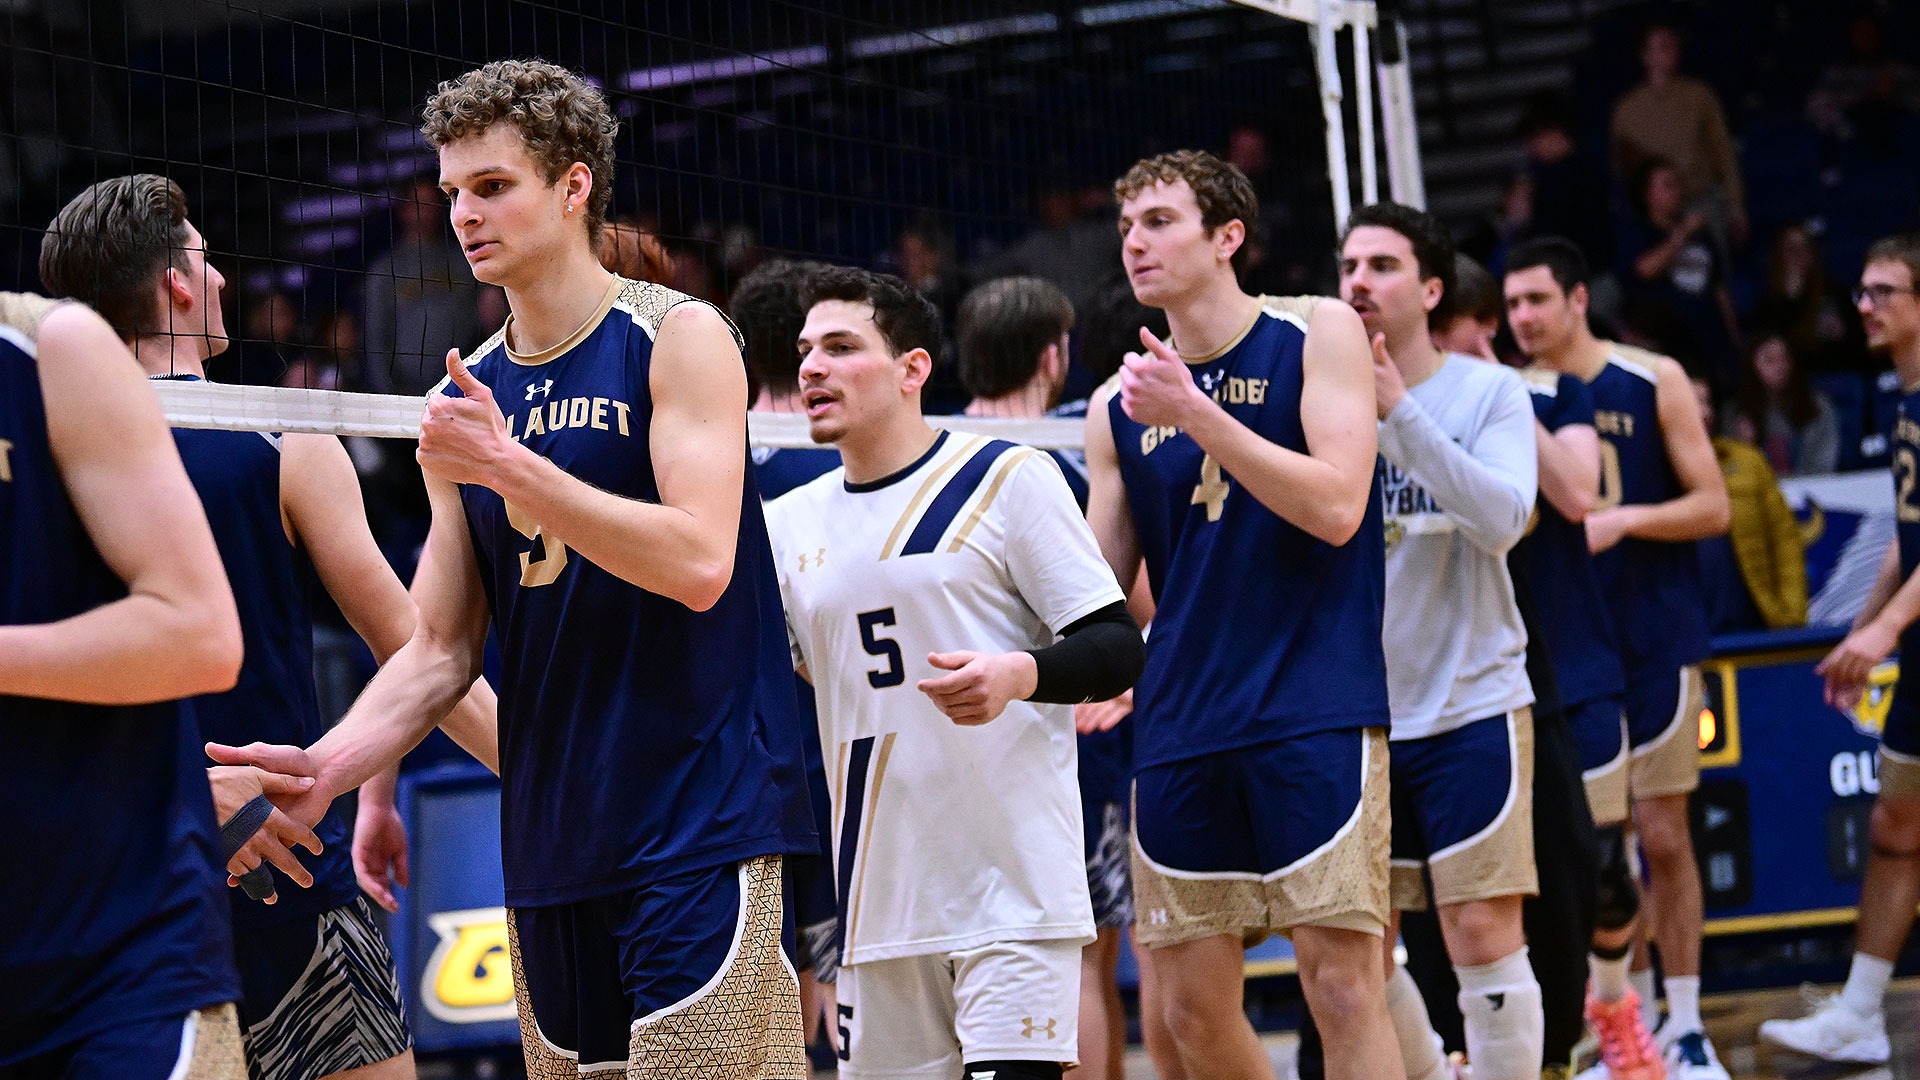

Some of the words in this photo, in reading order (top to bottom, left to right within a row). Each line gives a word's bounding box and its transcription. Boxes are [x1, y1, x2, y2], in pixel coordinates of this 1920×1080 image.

[507, 396, 632, 443] LAUDET
[856, 606, 905, 690] 5
[837, 1003, 854, 1062] 5
